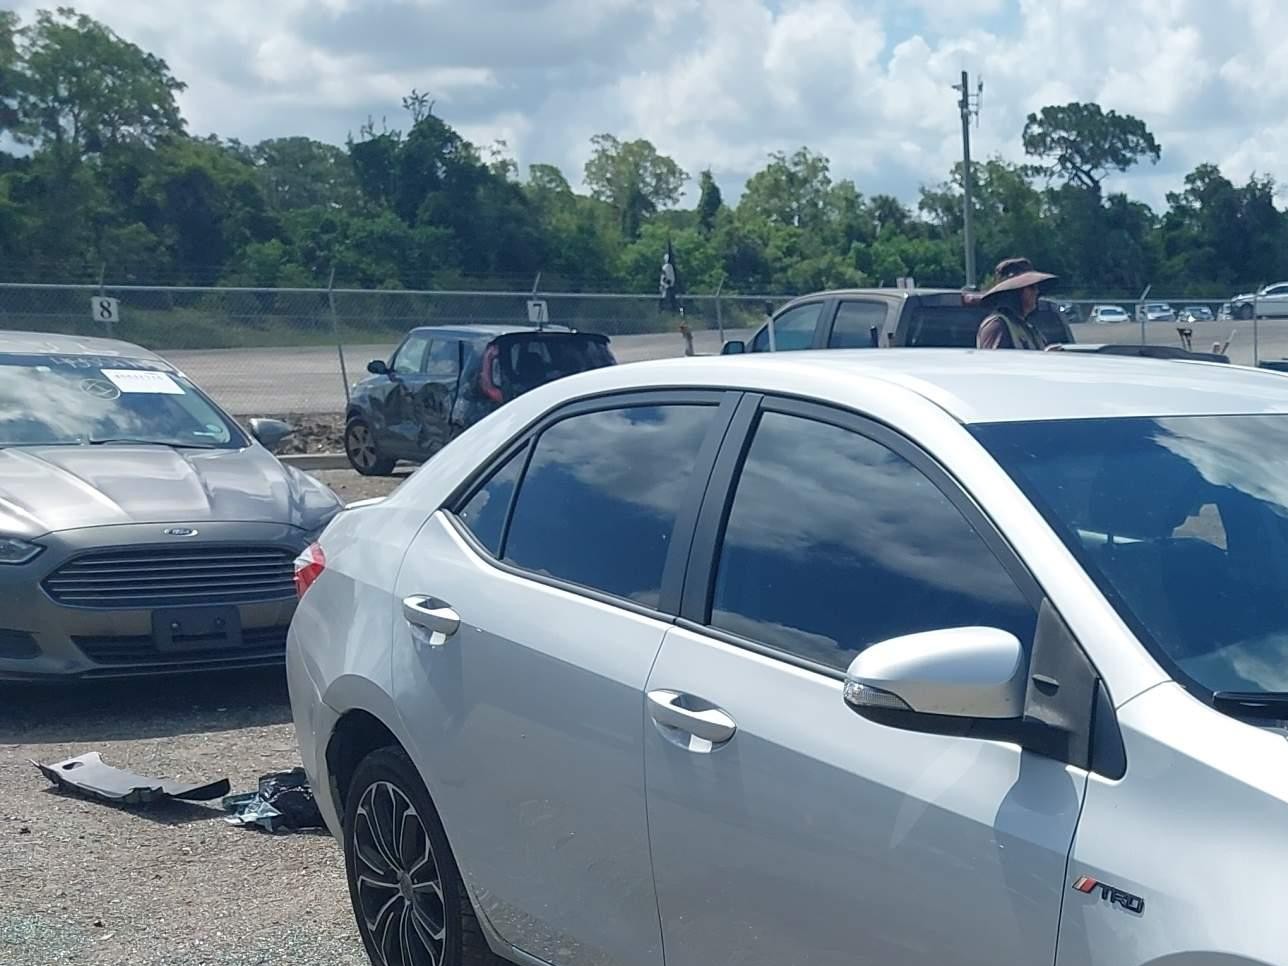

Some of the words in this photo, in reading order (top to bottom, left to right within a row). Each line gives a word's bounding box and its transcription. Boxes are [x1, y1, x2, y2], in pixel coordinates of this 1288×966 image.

[100, 300, 112, 319] 8
[532, 303, 542, 320] 7
[1096, 881, 1145, 914] TRD
